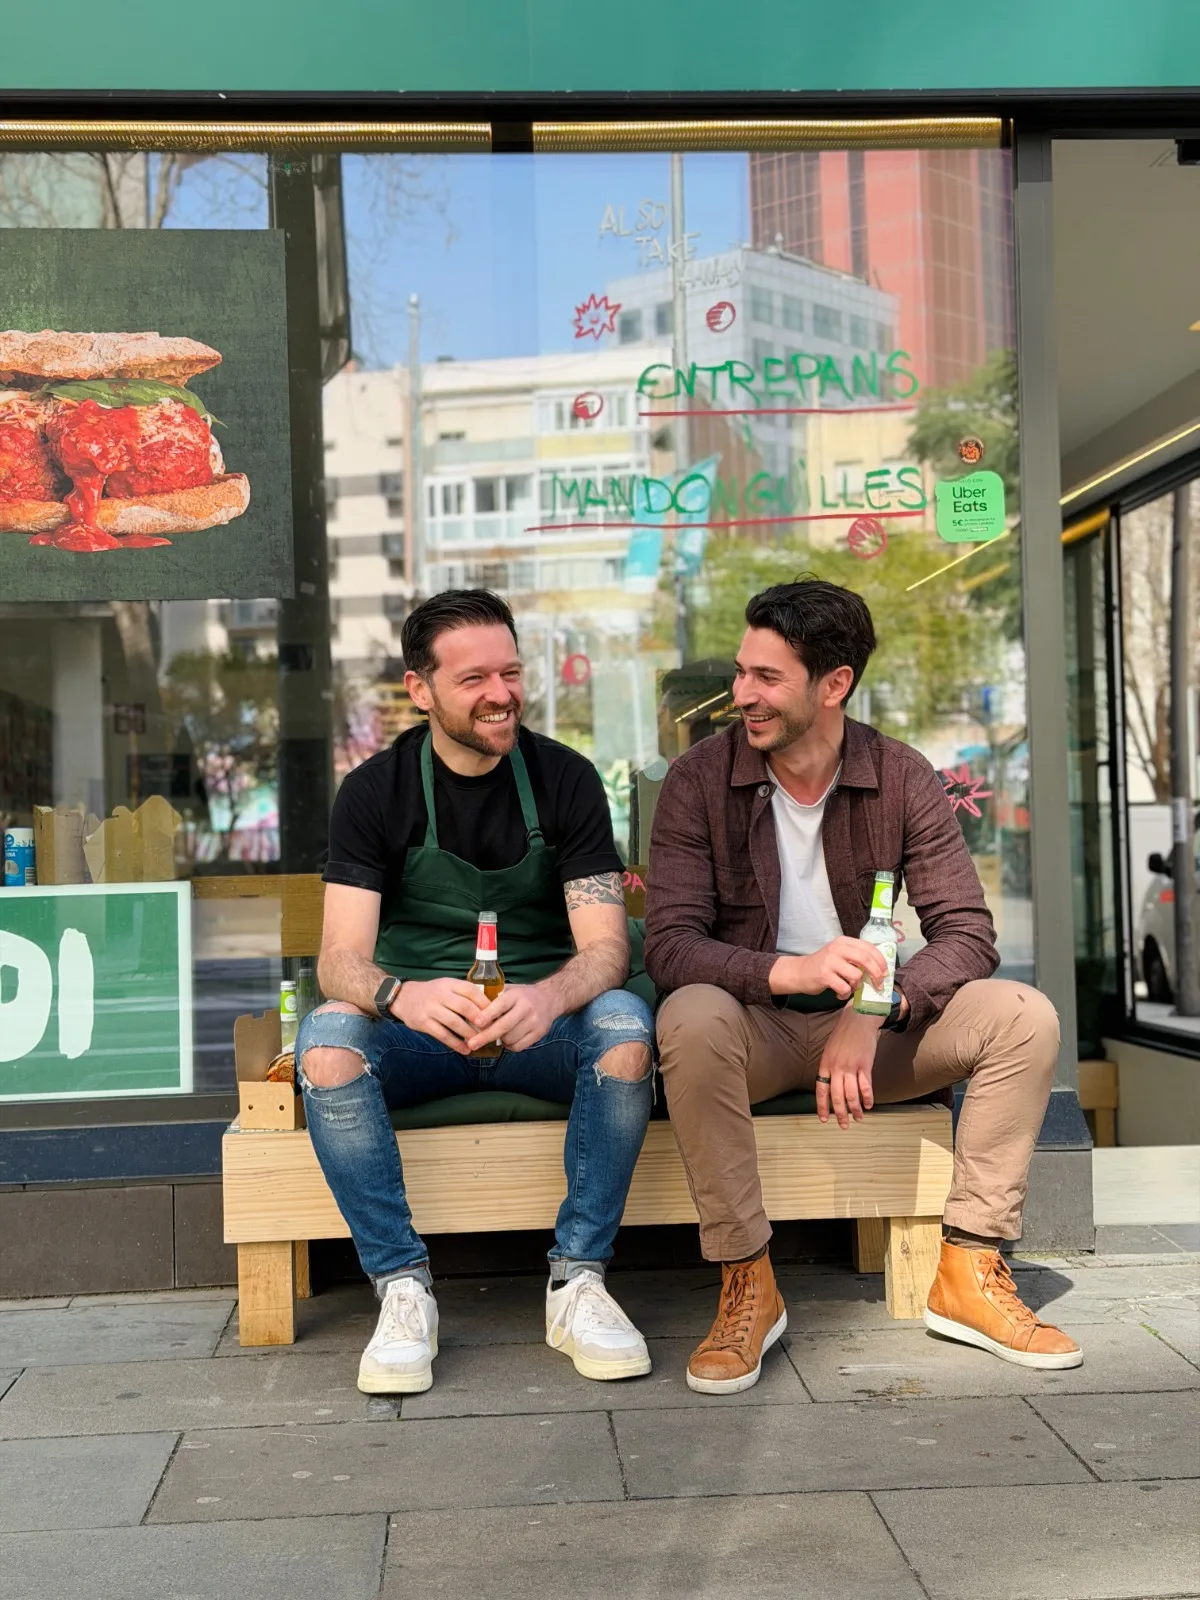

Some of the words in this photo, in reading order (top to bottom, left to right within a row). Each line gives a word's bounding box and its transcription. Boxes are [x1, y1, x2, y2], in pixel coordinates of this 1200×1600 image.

[599, 199, 669, 238] ALSO
[635, 231, 700, 268] TAKE
[637, 350, 920, 403] ENTREPANS
[952, 486, 987, 499] Uber
[953, 500, 988, 513] Eats
